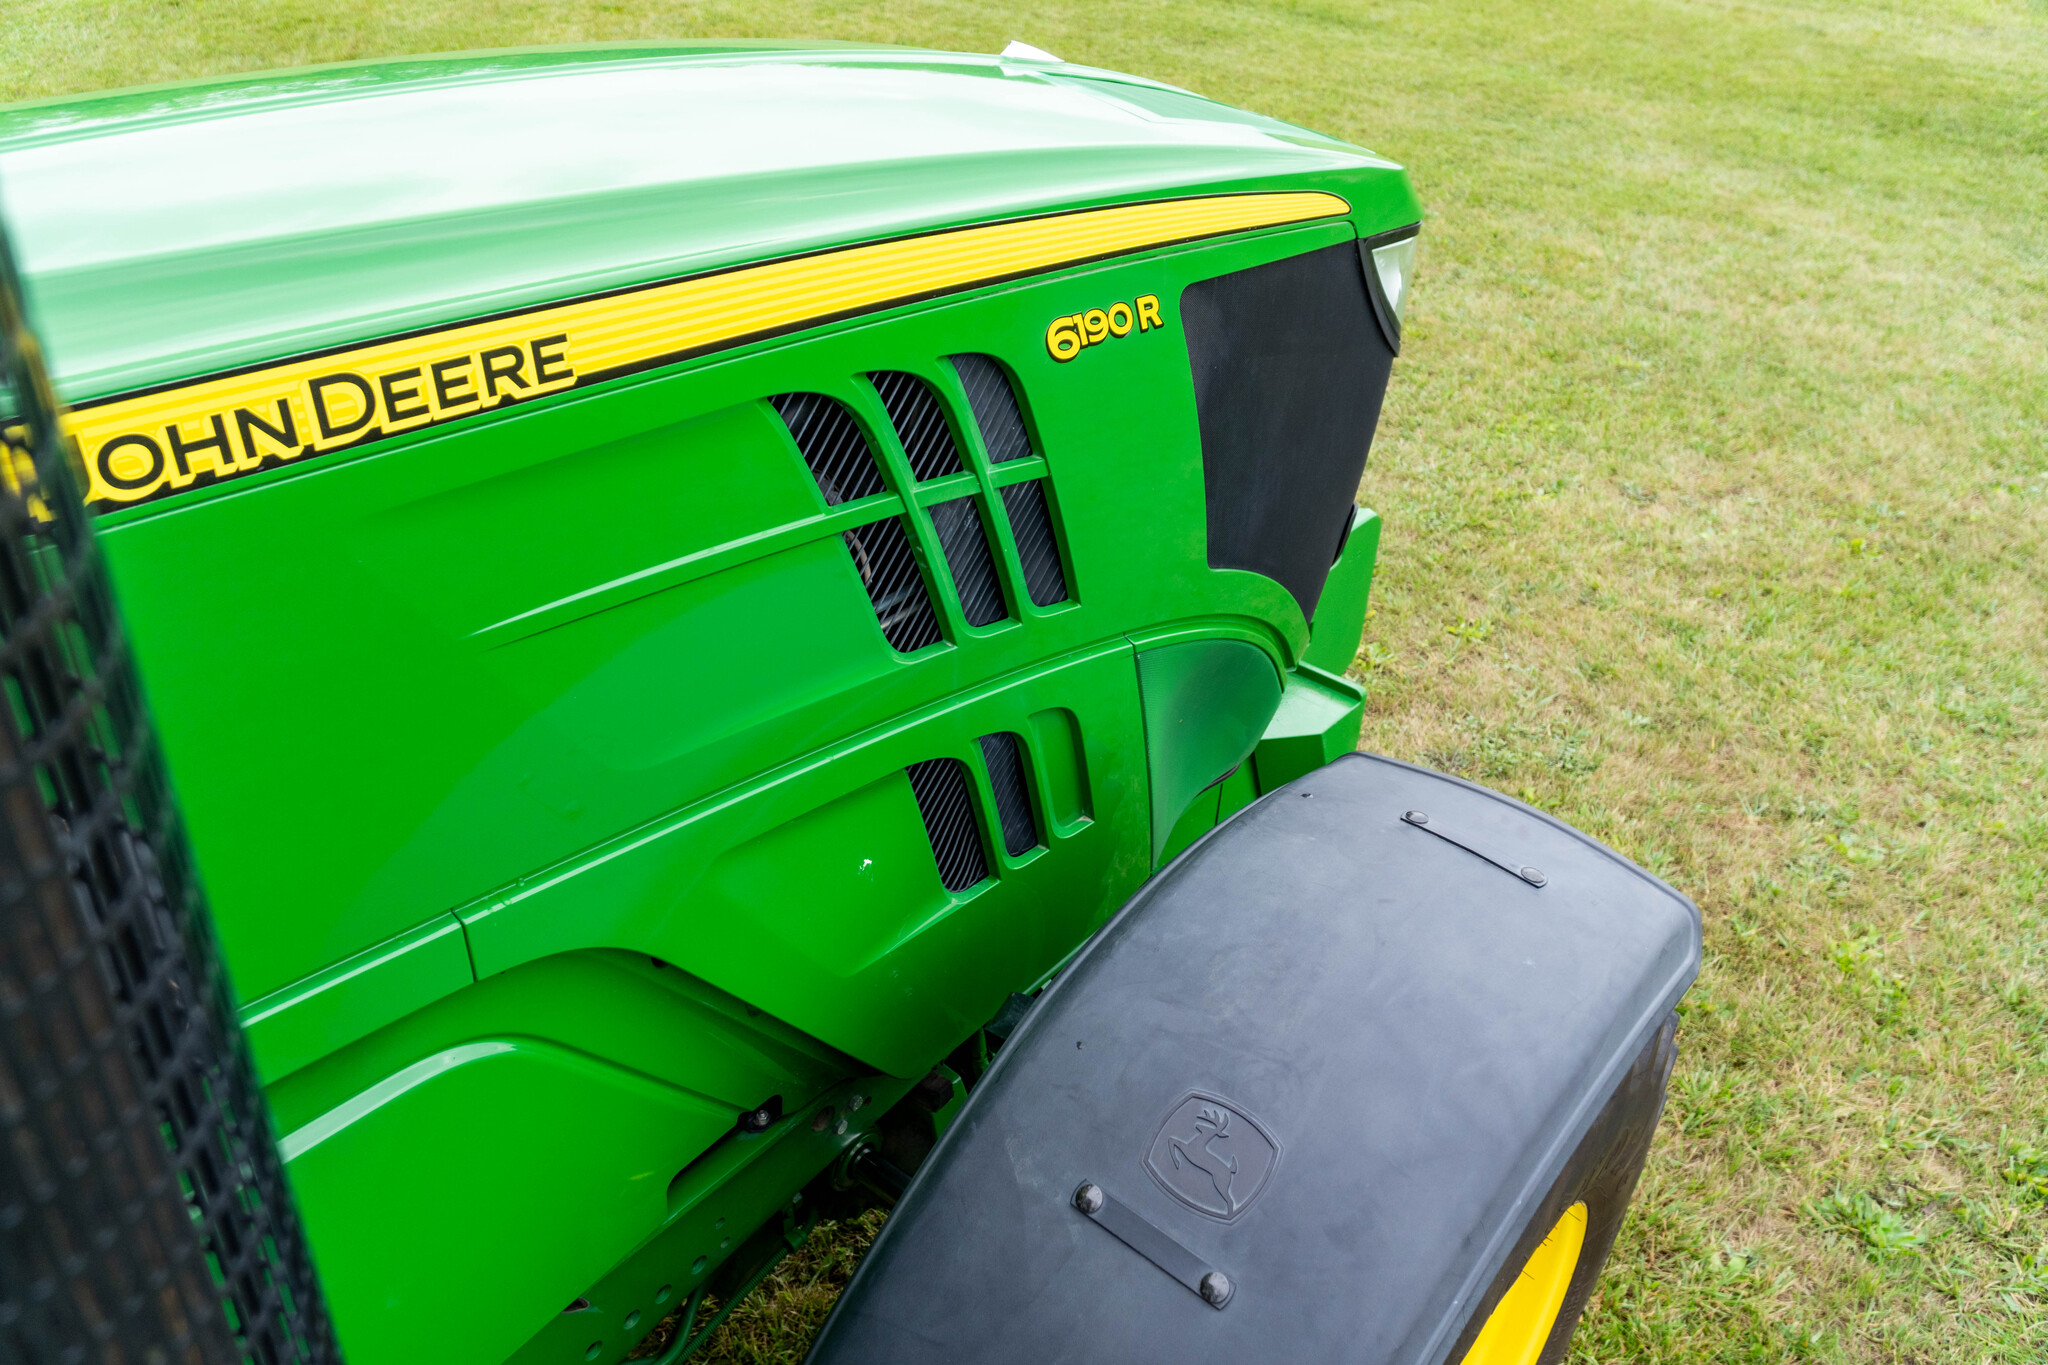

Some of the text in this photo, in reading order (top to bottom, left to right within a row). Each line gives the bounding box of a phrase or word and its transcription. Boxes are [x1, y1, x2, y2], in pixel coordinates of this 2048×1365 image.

[1046, 294, 1164, 363] 6190 R
[307, 332, 577, 447] DEERE
